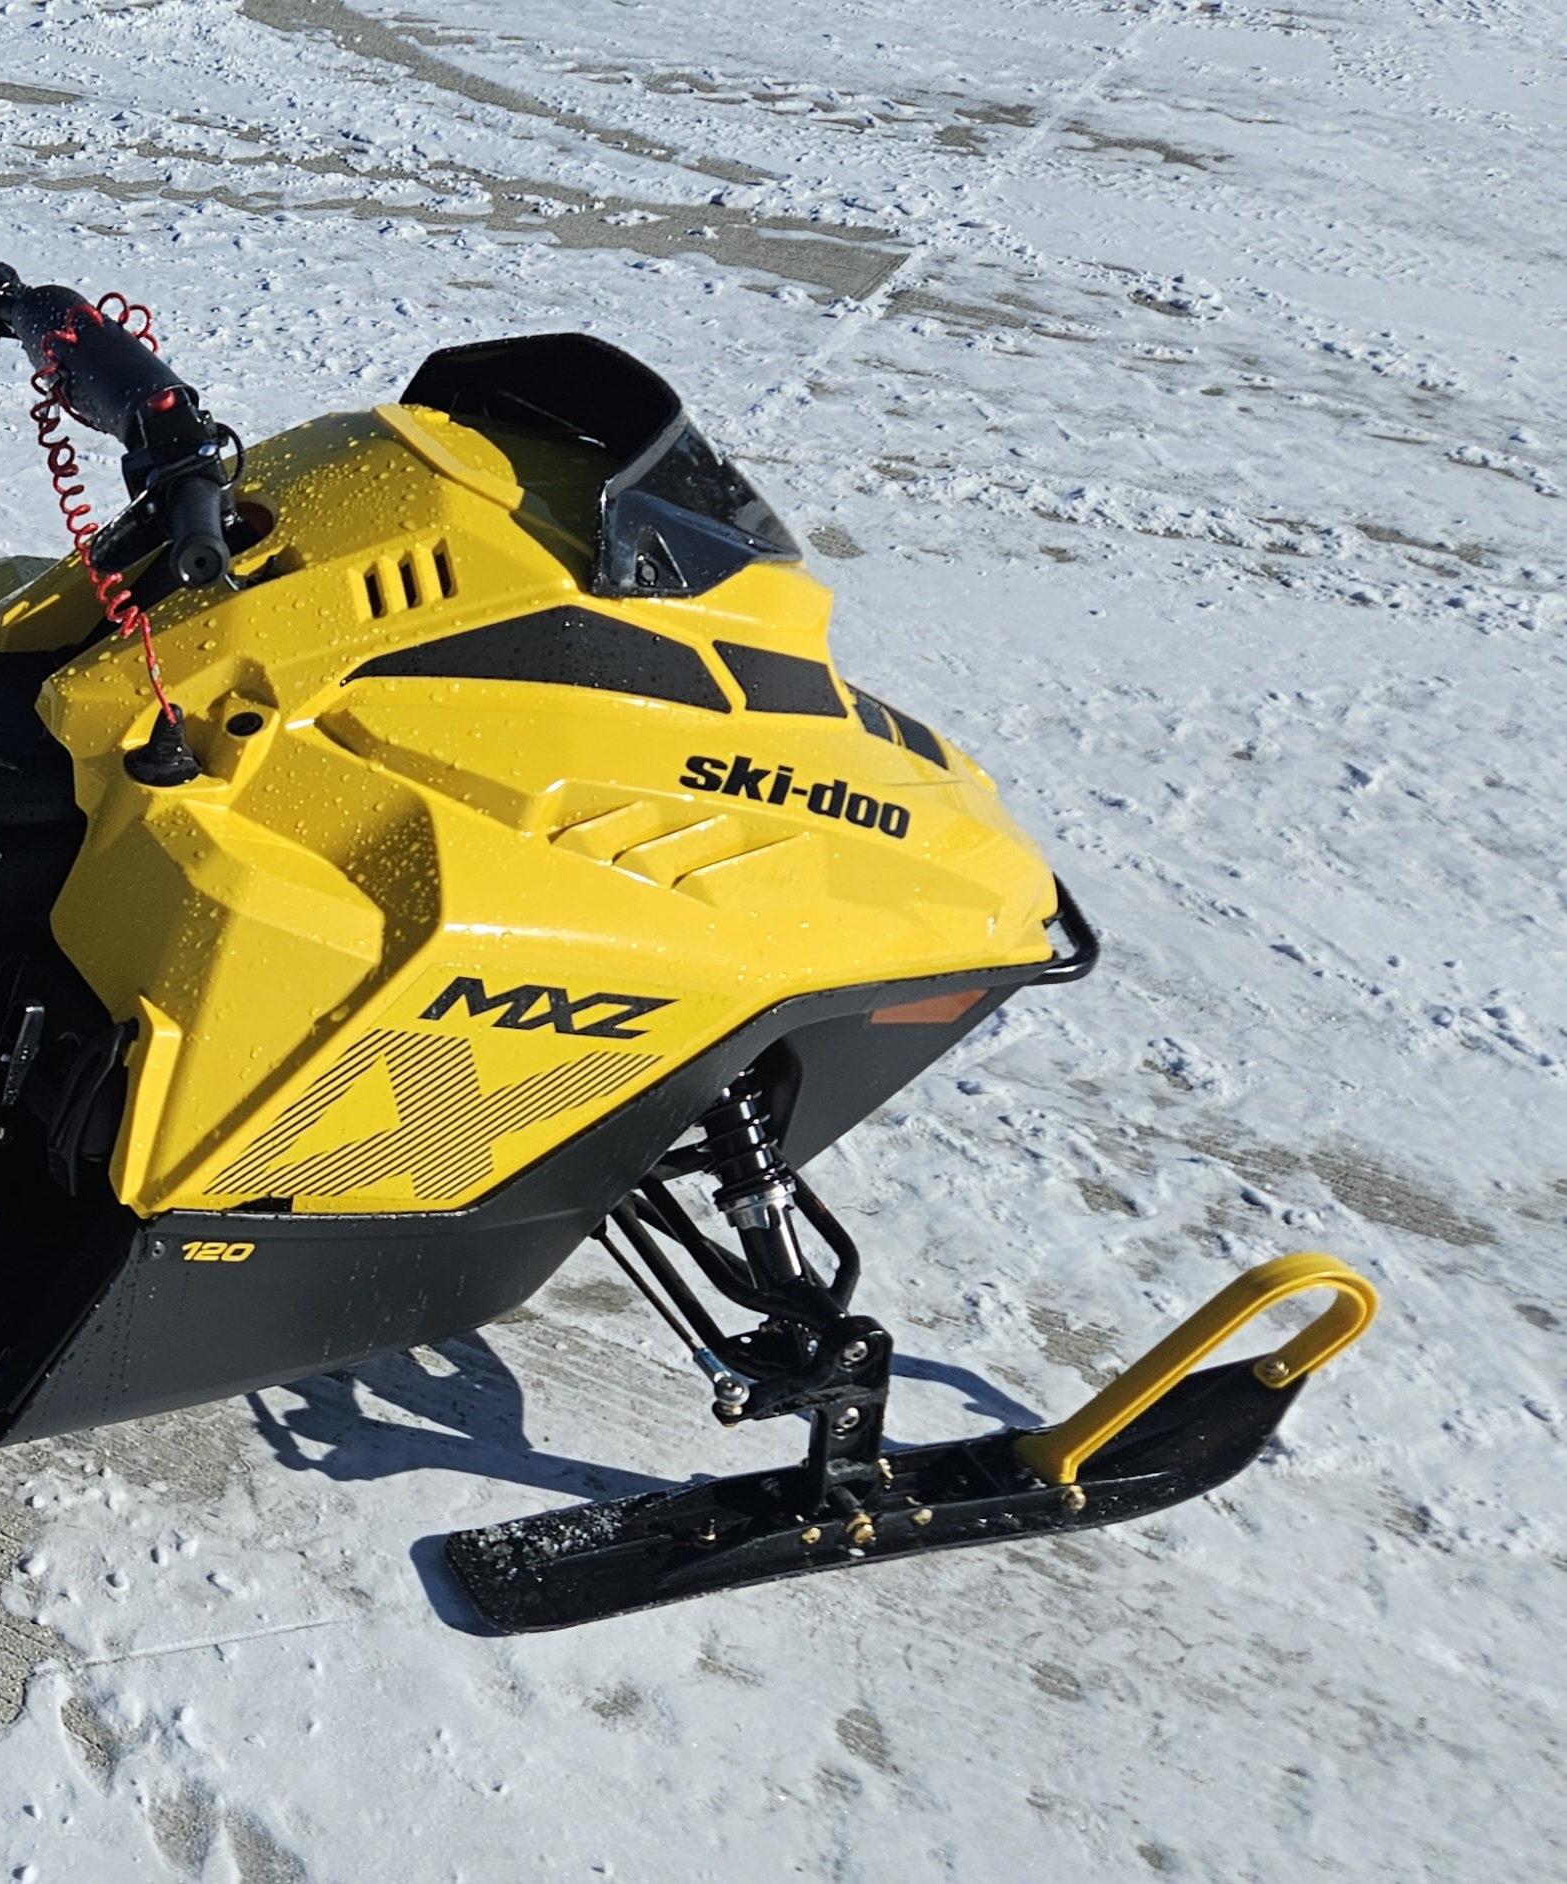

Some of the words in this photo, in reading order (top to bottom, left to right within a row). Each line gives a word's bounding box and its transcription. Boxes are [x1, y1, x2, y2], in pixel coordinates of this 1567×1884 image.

[679, 755, 911, 839] ski-doo
[417, 976, 681, 1039] MXZ
[181, 1241, 256, 1262] 120
